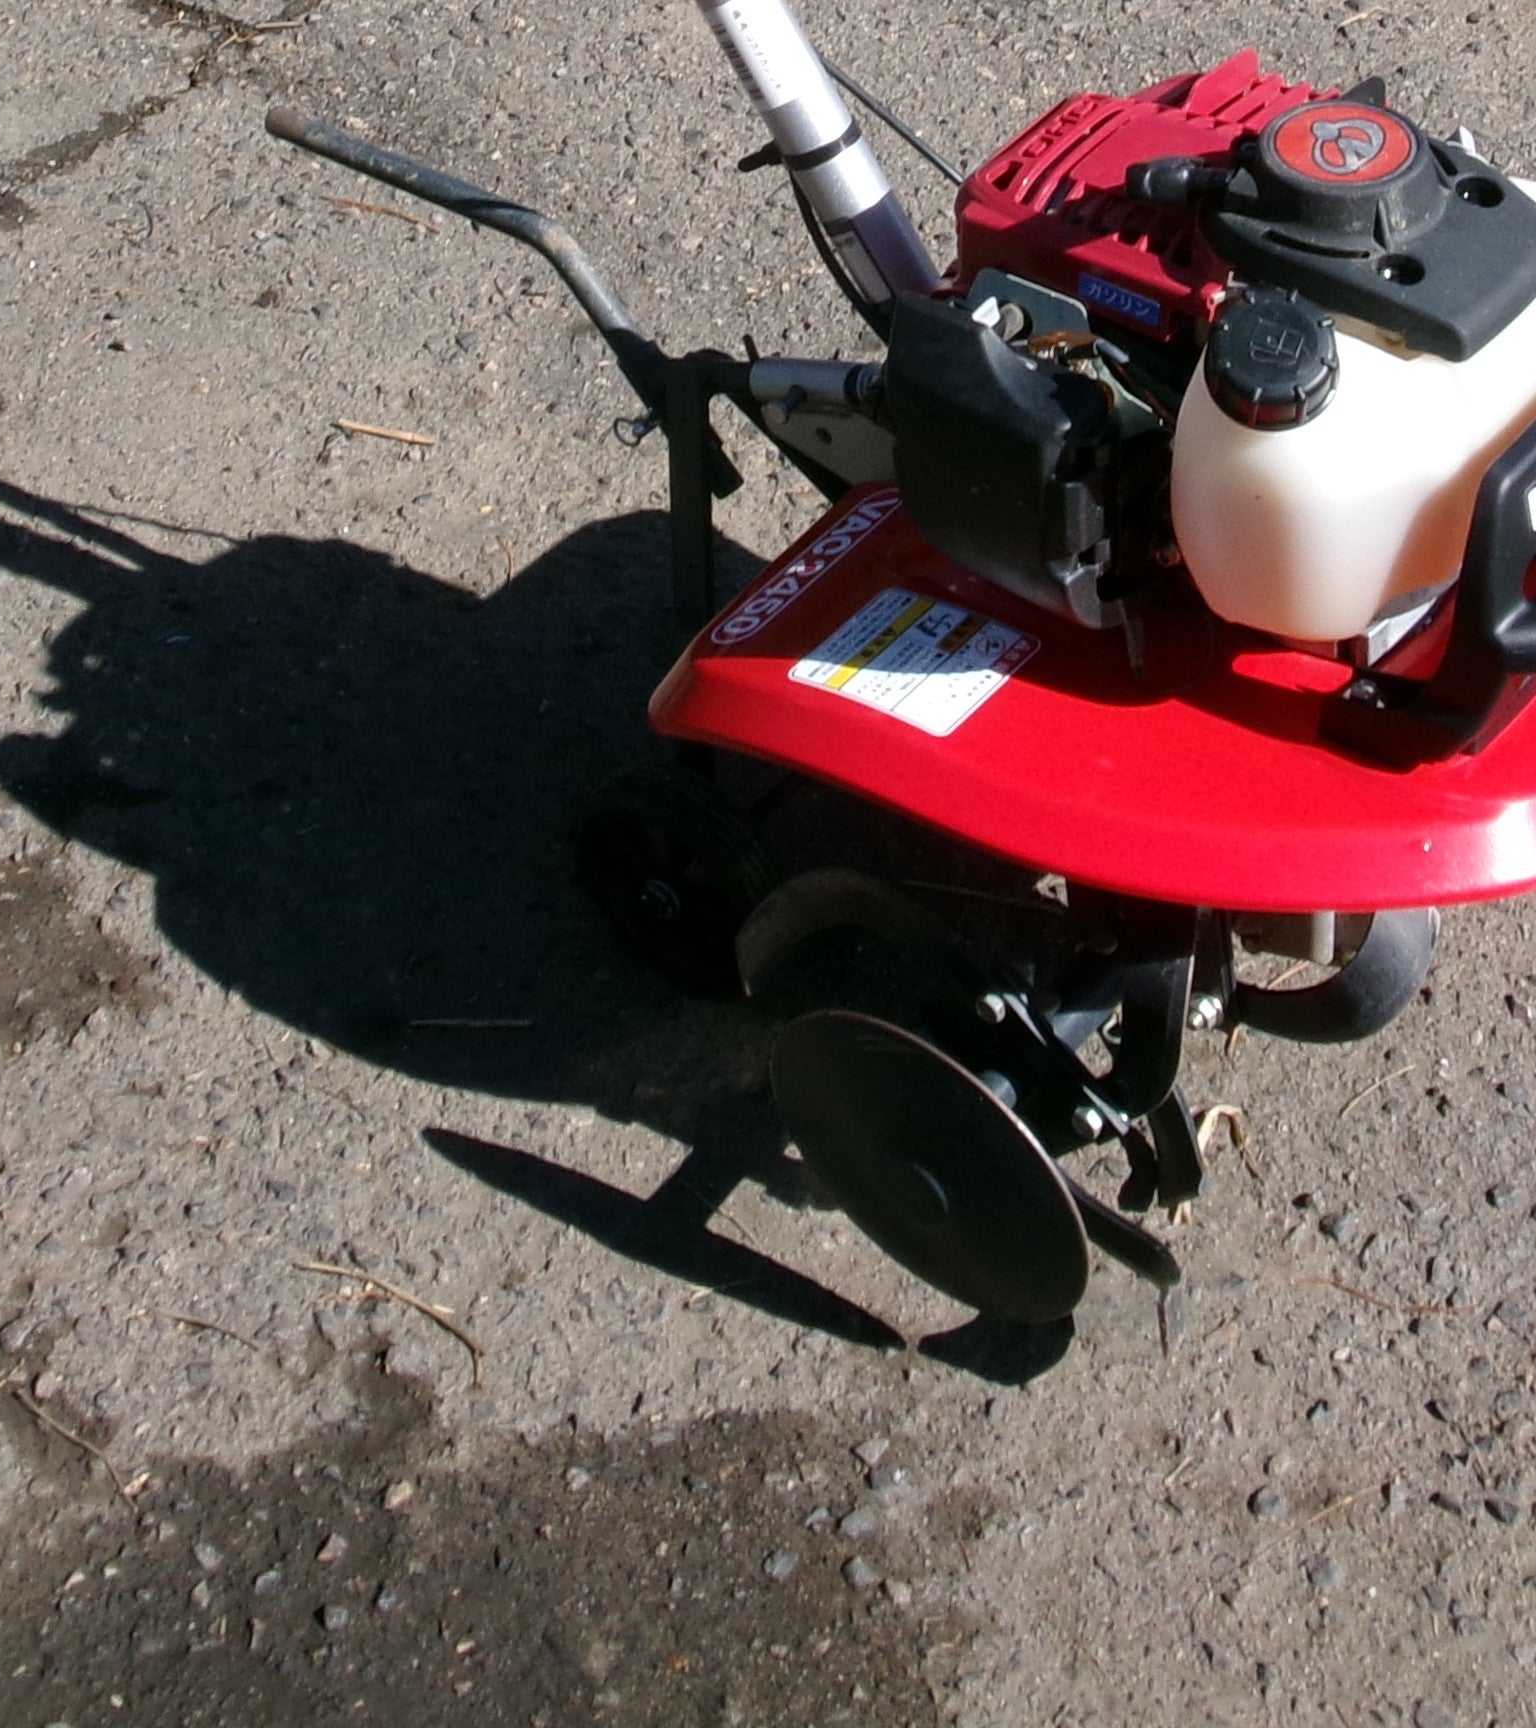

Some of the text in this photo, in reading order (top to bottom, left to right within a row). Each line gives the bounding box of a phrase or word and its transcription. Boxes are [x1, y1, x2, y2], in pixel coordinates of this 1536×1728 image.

[1088, 282, 1150, 316] ガソリン
[722, 497, 900, 634] VAC2450
